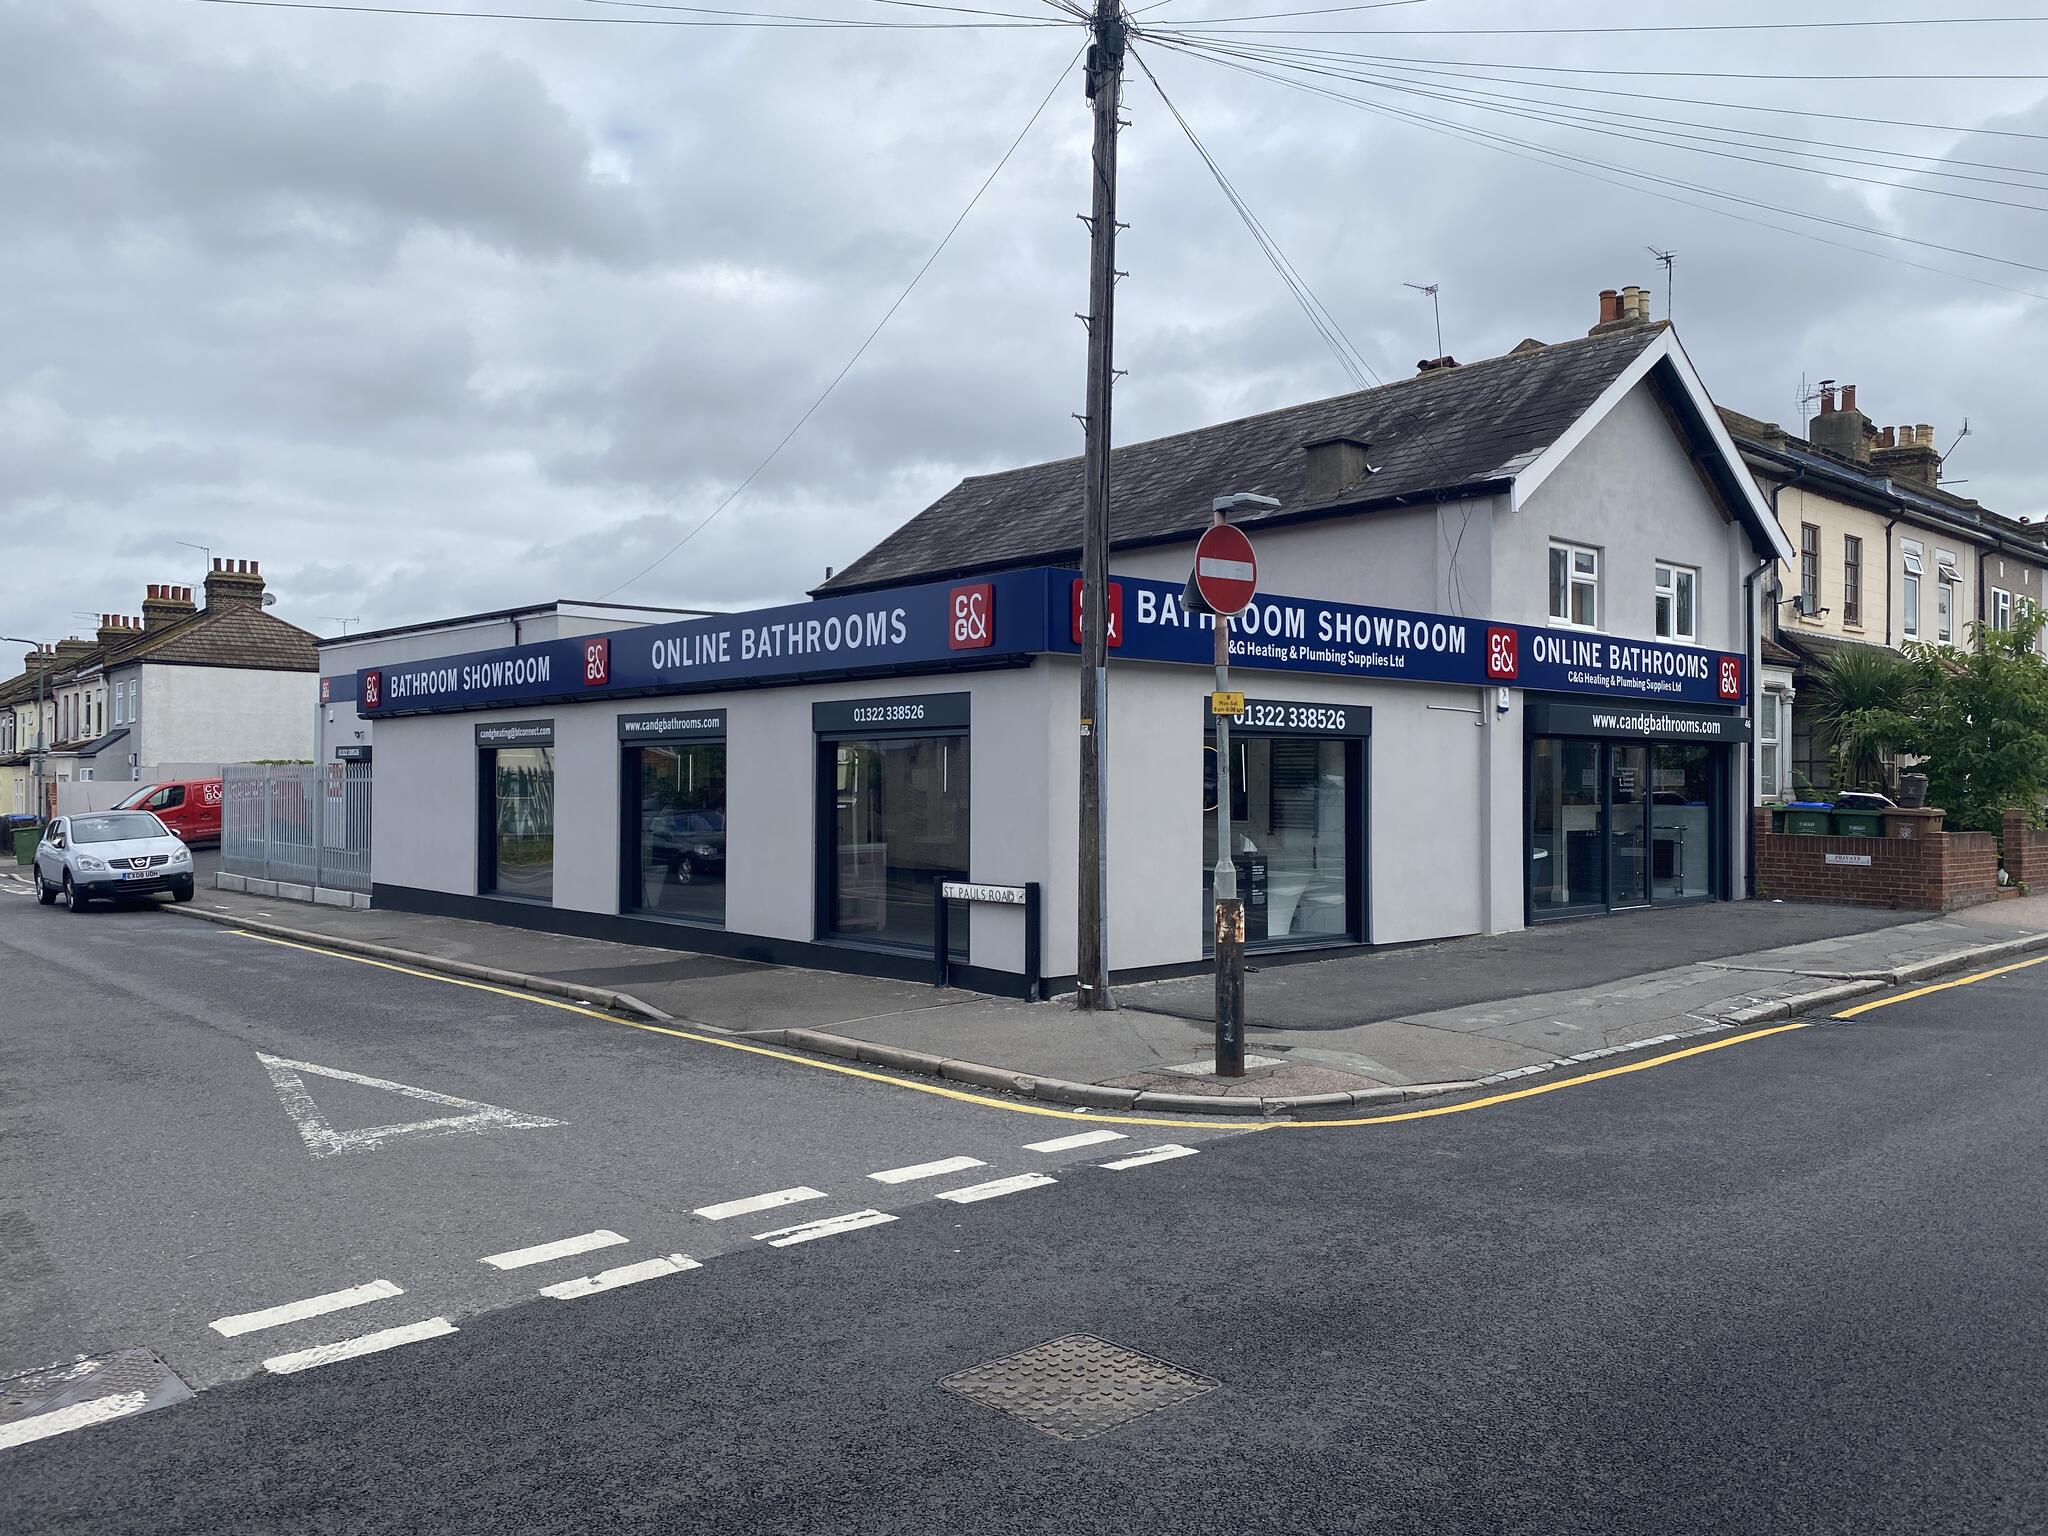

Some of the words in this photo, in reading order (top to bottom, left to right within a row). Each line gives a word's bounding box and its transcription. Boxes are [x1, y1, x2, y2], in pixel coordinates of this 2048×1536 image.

[651, 630, 731, 670] ONLINE
[741, 607, 907, 660] BATHROOMS
[1318, 611, 1466, 654] SHOWROOM
[1228, 640, 1246, 655] &G
[1247, 641, 1288, 661] Heating
[1289, 645, 1298, 660] &
[1300, 646, 1347, 666] Plumbing
[1348, 650, 1389, 668] Supplies
[1389, 654, 1405, 668] Ltd
[1533, 635, 1602, 668] ONLINE
[1609, 645, 1709, 679] BATHROOMS
[391, 668, 458, 698] BATHROOM
[463, 655, 550, 691] SHOWROOM
[1568, 671, 1584, 683] C&G
[1584, 672, 1610, 688] Heating
[1610, 675, 1616, 686] &
[1616, 675, 1646, 691] Plumbing
[1646, 678, 1672, 693] Supplies
[1672, 681, 1682, 692] Ltd
[854, 707, 884, 722] 01322
[886, 704, 924, 720] 338526
[1233, 705, 1285, 727] 01322
[1288, 706, 1346, 730] 338526
[1592, 713, 1721, 735] www.candgbathrooms.com
[1745, 720, 1751, 729] 46
[625, 717, 720, 733] www.candgbathrooms.com
[958, 887, 986, 900] PAULS
[988, 889, 1015, 902] ROAD
